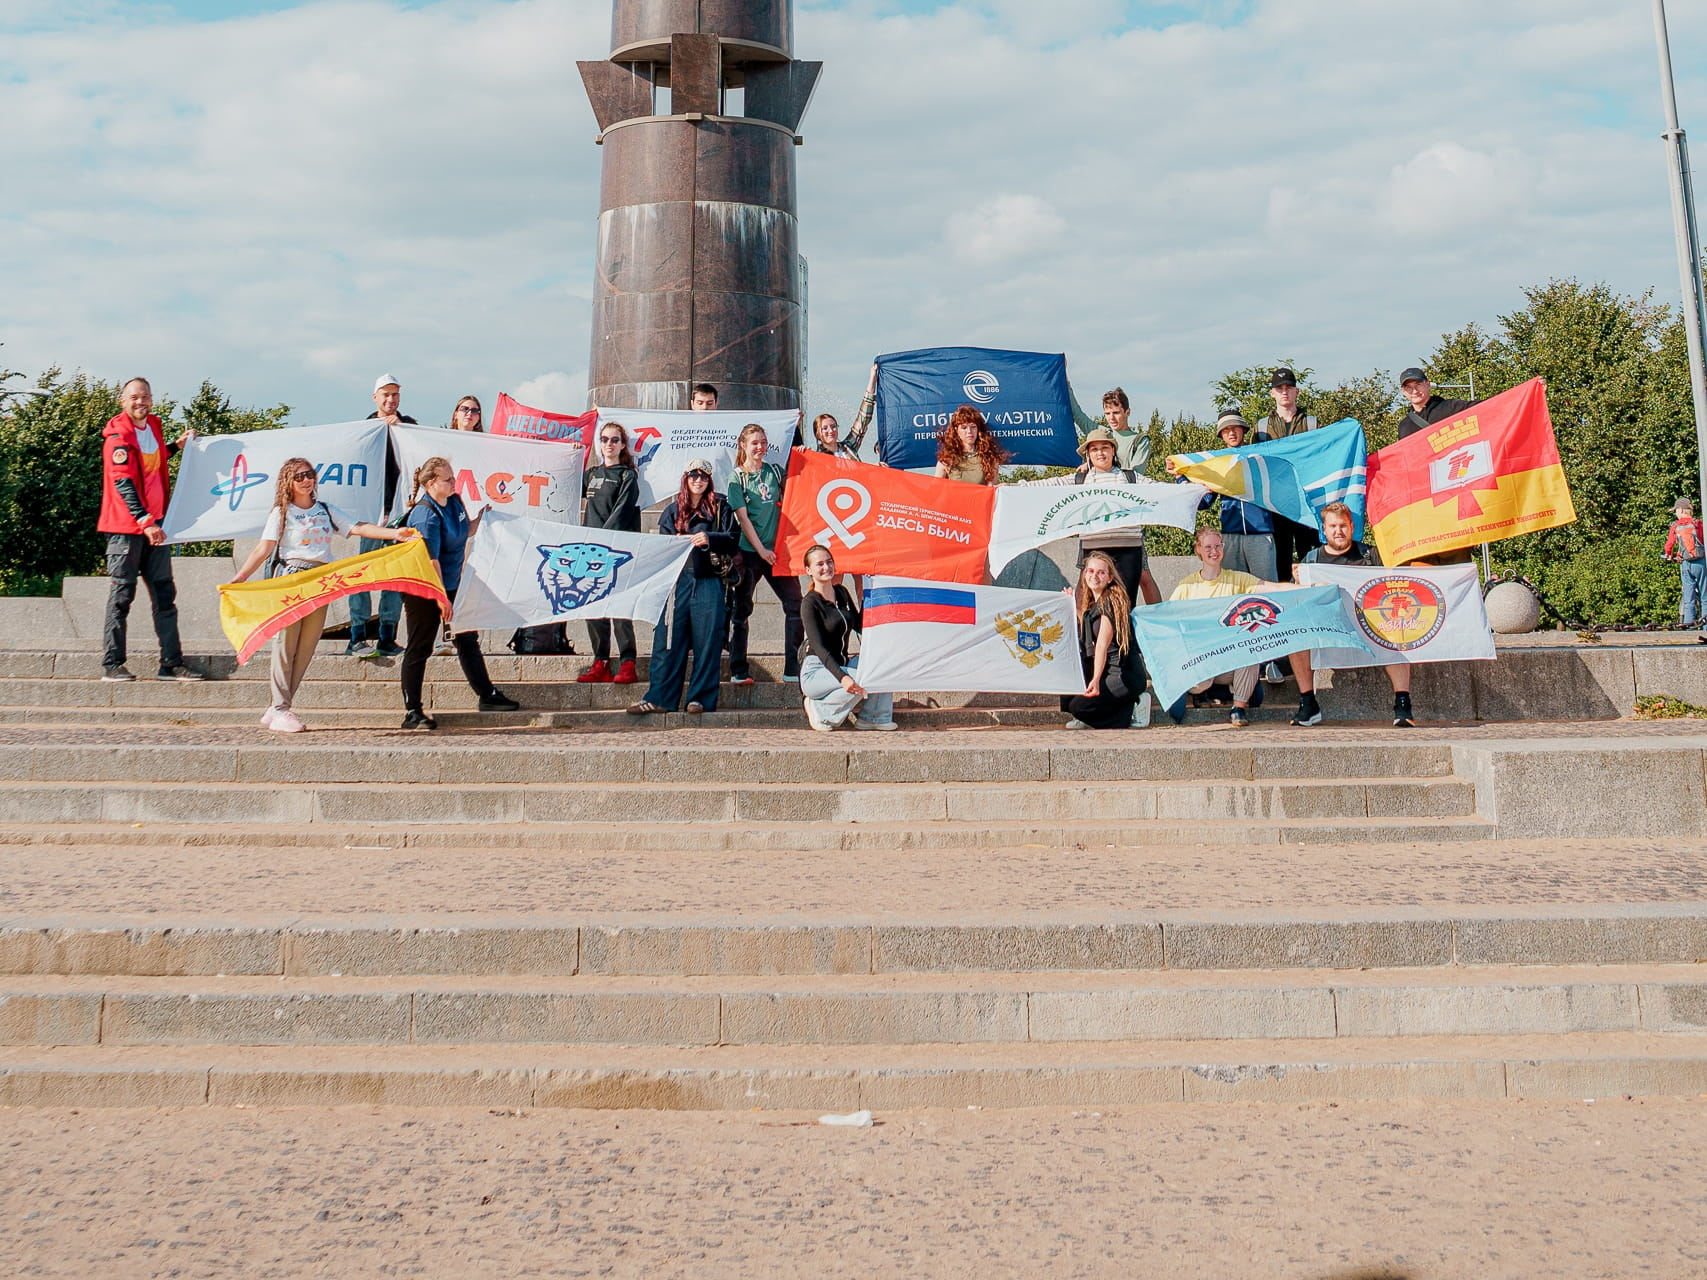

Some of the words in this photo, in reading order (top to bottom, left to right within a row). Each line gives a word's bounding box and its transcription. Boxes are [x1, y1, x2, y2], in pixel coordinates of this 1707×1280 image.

[506, 415, 584, 442] WELCOME
[995, 411, 1052, 424] «ЛЭТИ»
[876, 514, 925, 532] ЗДЕСЬ
[927, 523, 970, 545] БЫЛИ
[1181, 644, 1236, 670] ФЕДЕРАЦИЯ
[1237, 627, 1308, 649] СПОРТИВНОГО
[1249, 638, 1289, 655] РОССИИ
